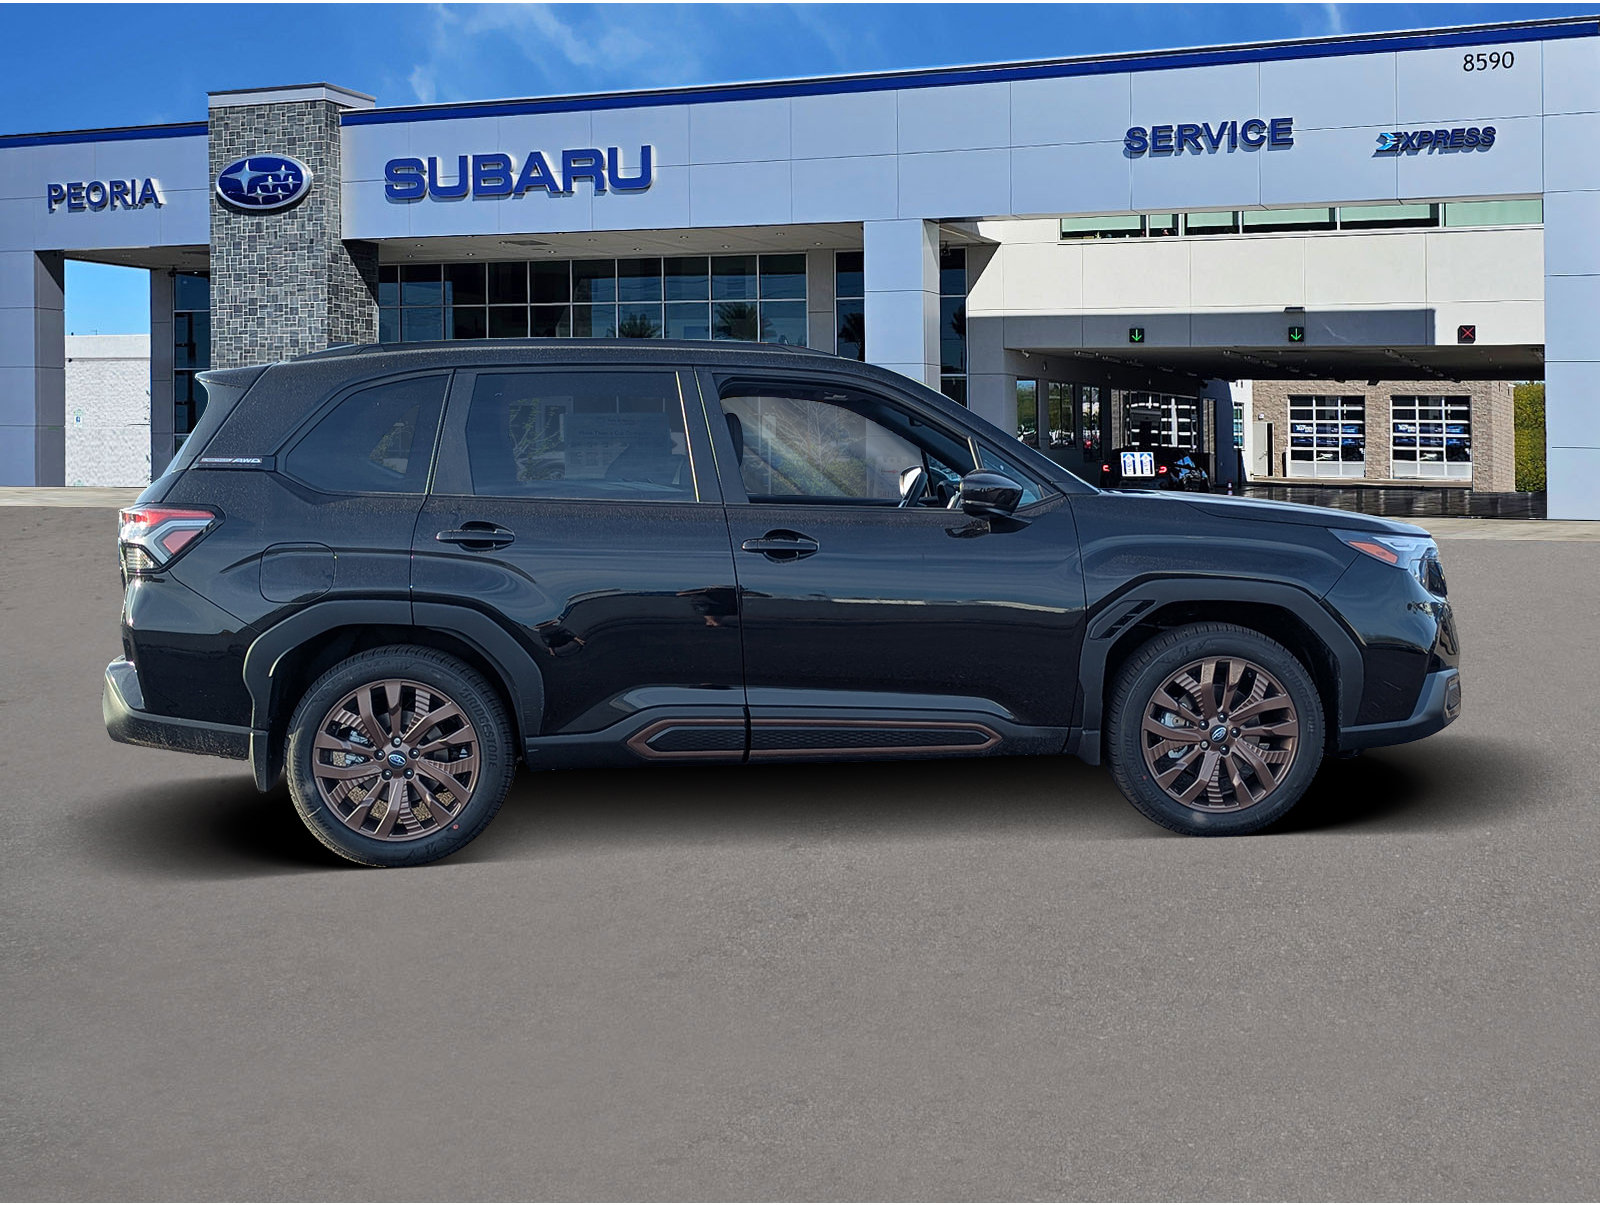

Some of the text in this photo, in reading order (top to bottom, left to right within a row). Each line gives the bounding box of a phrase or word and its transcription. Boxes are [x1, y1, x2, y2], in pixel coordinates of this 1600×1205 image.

[1462, 51, 1515, 72] 8590
[1124, 117, 1294, 152] SERVICE
[1376, 127, 1497, 151] EXPRESS
[385, 144, 653, 200] SUBARU
[48, 178, 162, 210] PEORIA
[459, 685, 498, 768] BRIDGESTONE
